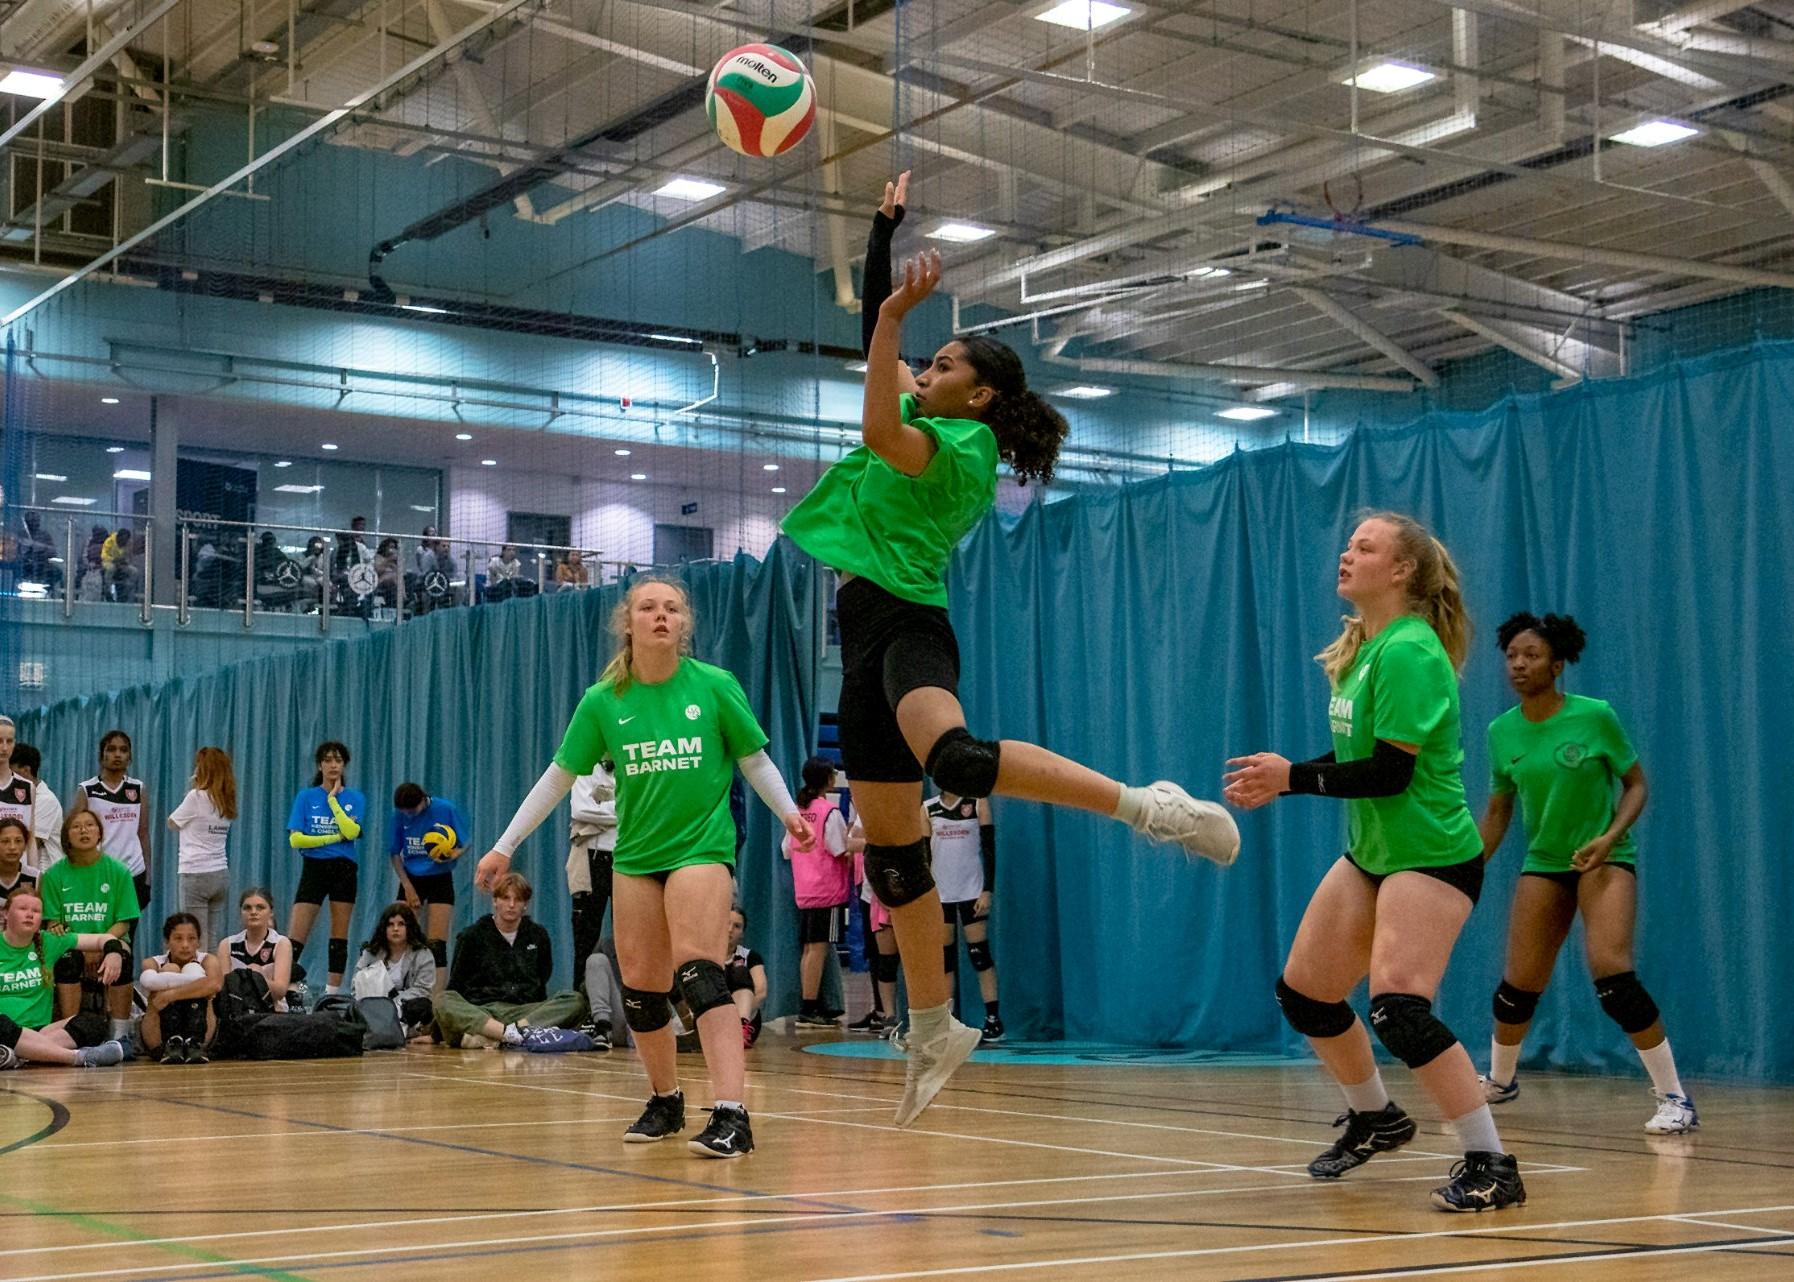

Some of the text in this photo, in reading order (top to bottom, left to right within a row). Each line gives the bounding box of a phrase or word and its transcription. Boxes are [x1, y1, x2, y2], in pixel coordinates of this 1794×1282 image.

[736, 55, 779, 83] molten
[622, 737, 702, 761] TEAM
[625, 756, 703, 777] BARNET
[311, 815, 337, 825] TEA
[63, 901, 108, 914] TEAM
[0, 978, 42, 993] ARNET
